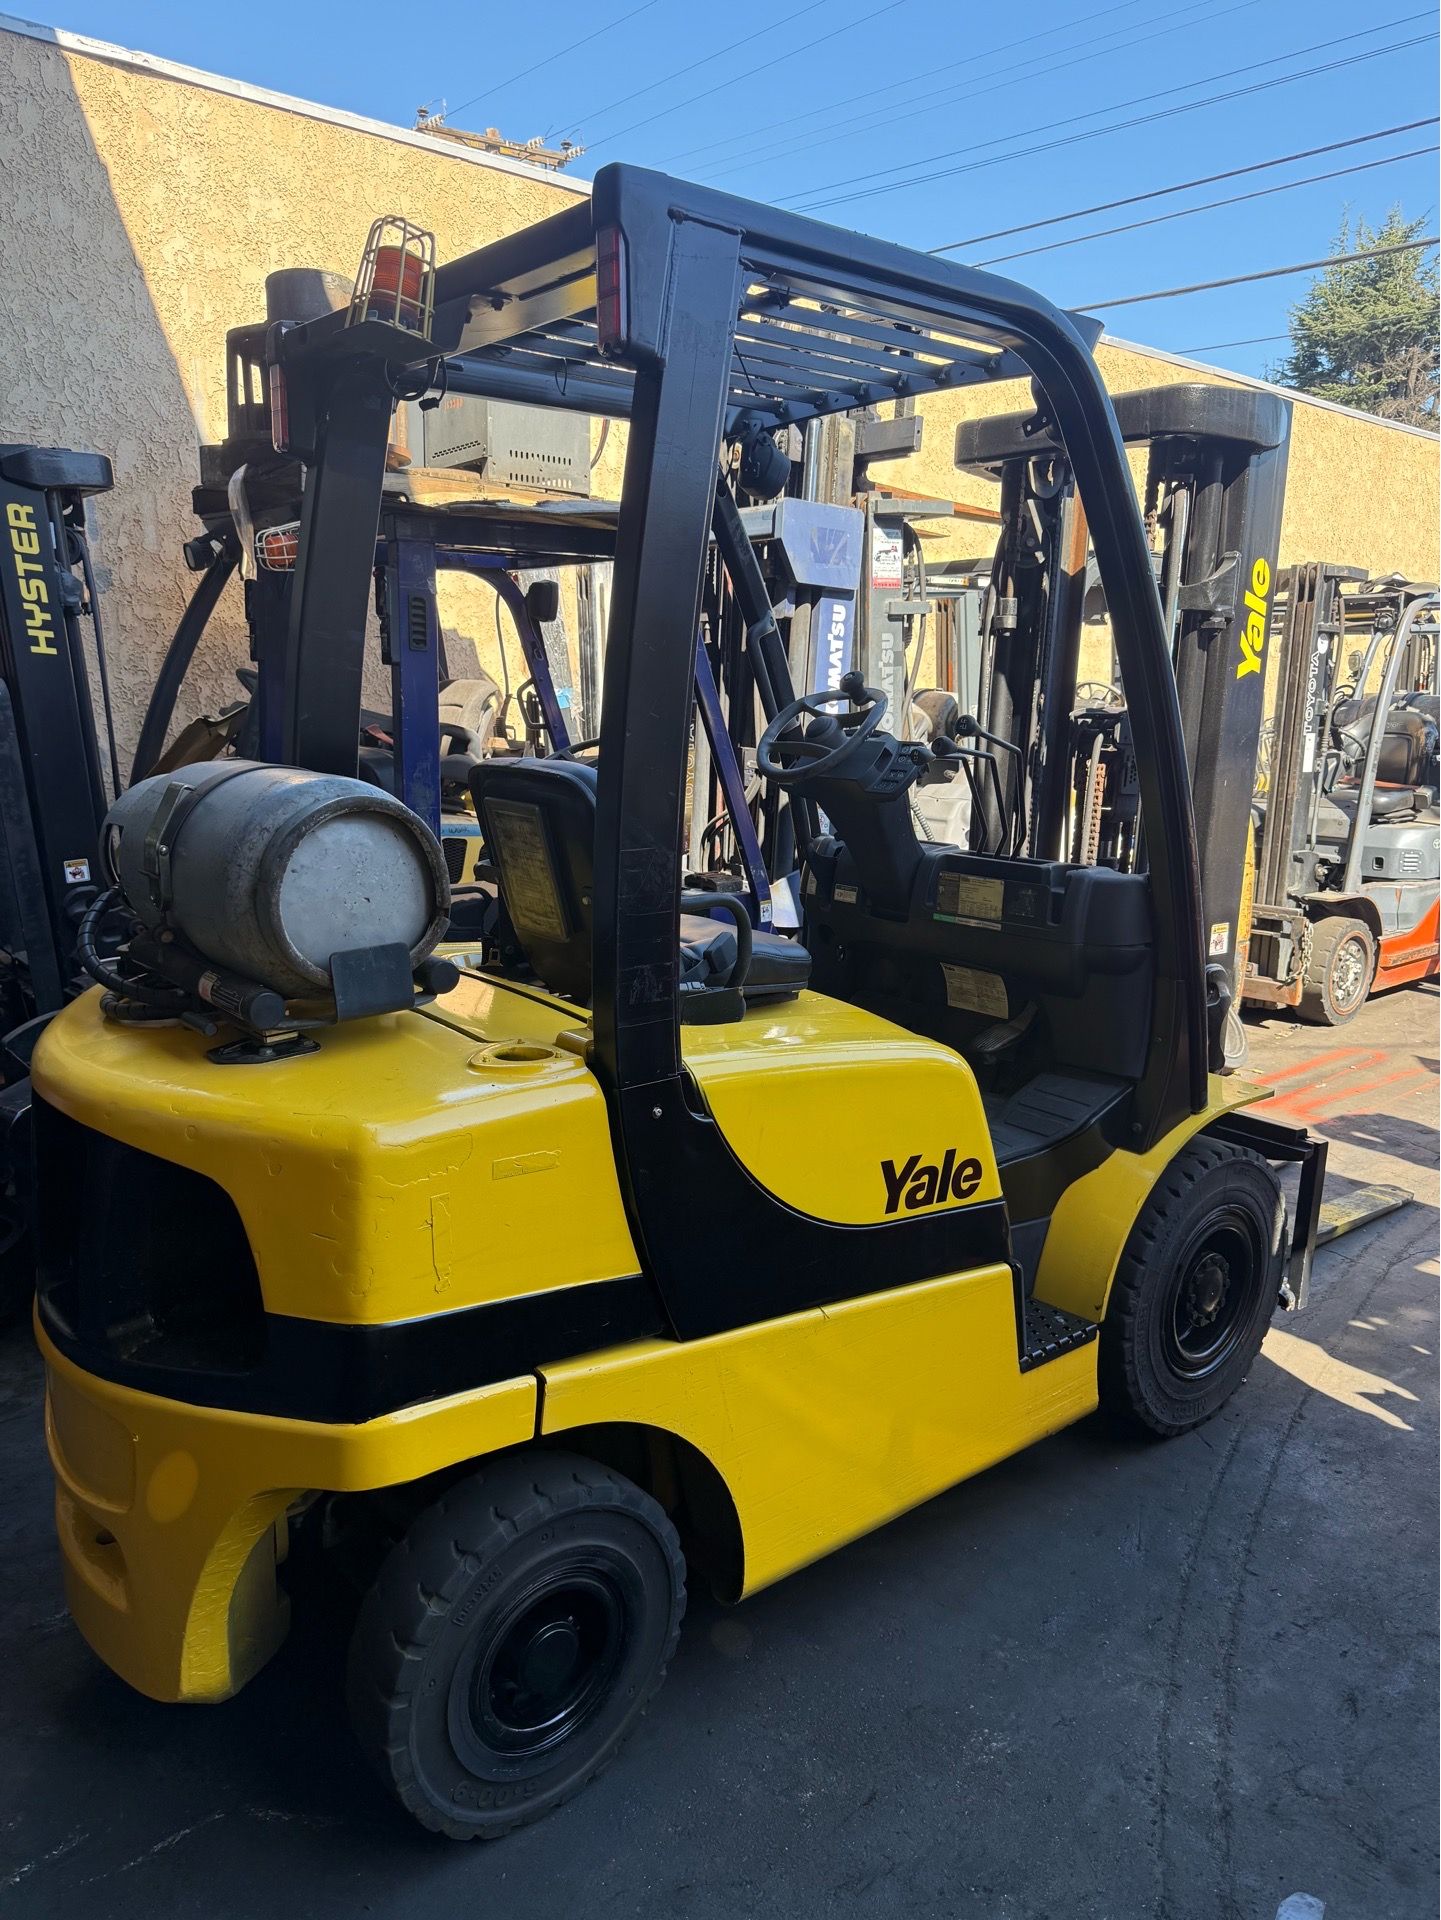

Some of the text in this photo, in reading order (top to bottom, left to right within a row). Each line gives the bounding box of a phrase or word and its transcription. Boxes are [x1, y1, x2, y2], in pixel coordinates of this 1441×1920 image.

[6, 503, 58, 656] HYSTER
[1236, 558, 1270, 680] Yale
[826, 604, 847, 714] KMATSU
[879, 633, 895, 734] OMATSU
[1304, 652, 1320, 735] TOYOTA
[881, 1148, 983, 1215] Yale
